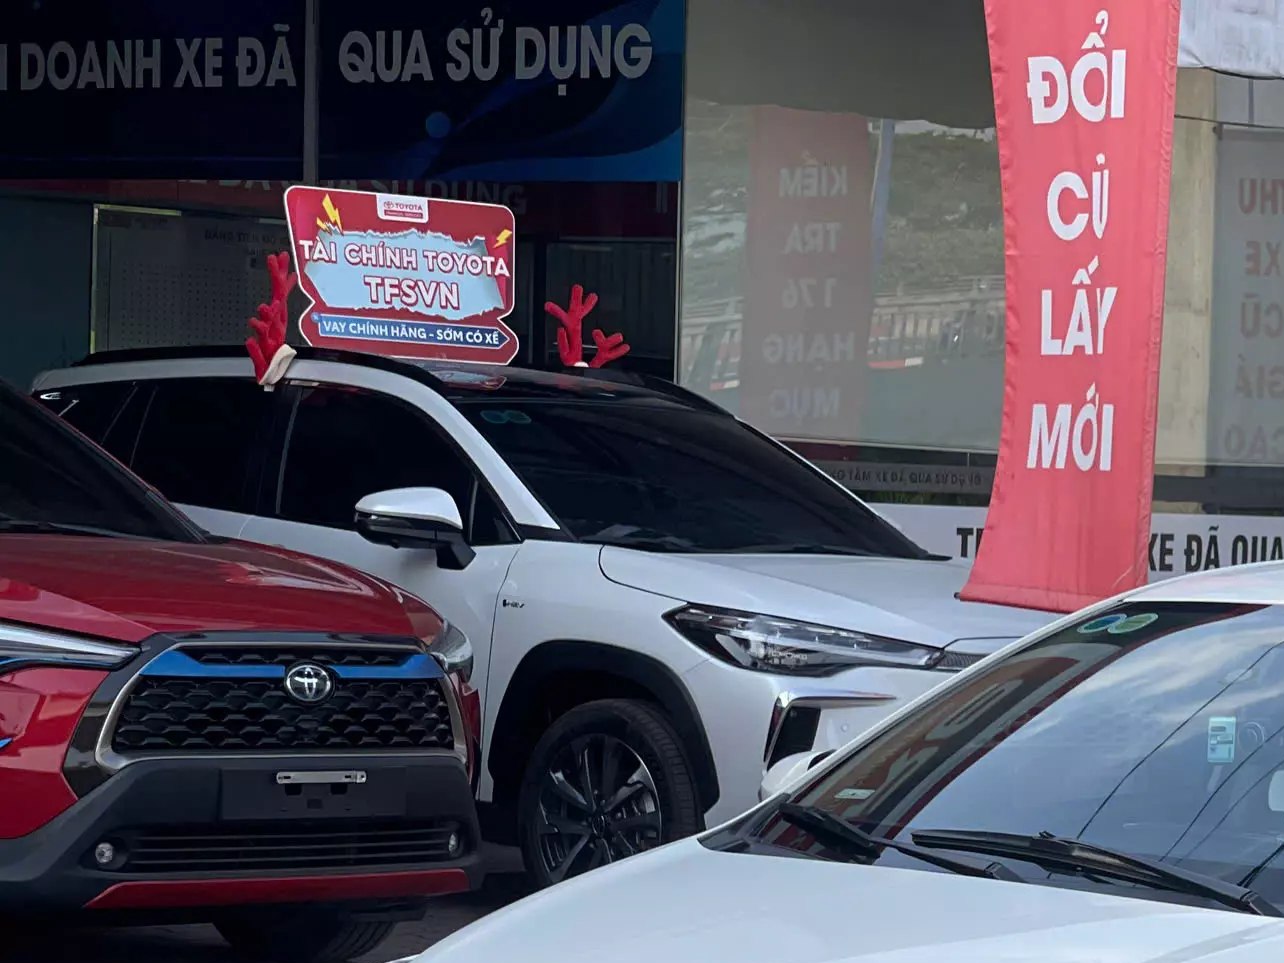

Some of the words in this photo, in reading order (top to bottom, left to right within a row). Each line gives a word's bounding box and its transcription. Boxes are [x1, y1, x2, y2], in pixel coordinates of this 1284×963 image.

[20, 39, 161, 91] DOANH
[173, 37, 223, 88] XE
[235, 23, 297, 88] ĐÃ
[338, 29, 434, 83] QUA
[446, 7, 504, 81] SỬ
[515, 23, 653, 96] DỤNG
[1026, 9, 1127, 125] ĐỔI
[299, 235, 338, 263] TÀI
[344, 240, 419, 270] CHÍNH
[423, 250, 511, 277] TOYOTA
[364, 275, 461, 310] TFSVN
[1041, 255, 1119, 356] LẤY
[323, 320, 347, 333] VAY
[349, 320, 389, 337] CHÍNH
[391, 323, 427, 339] HÃNG
[436, 327, 464, 342] SỚM
[466, 329, 483, 344] CÓ
[1026, 382, 1115, 472] MỚI
[1184, 525, 1220, 572] ĐÃ
